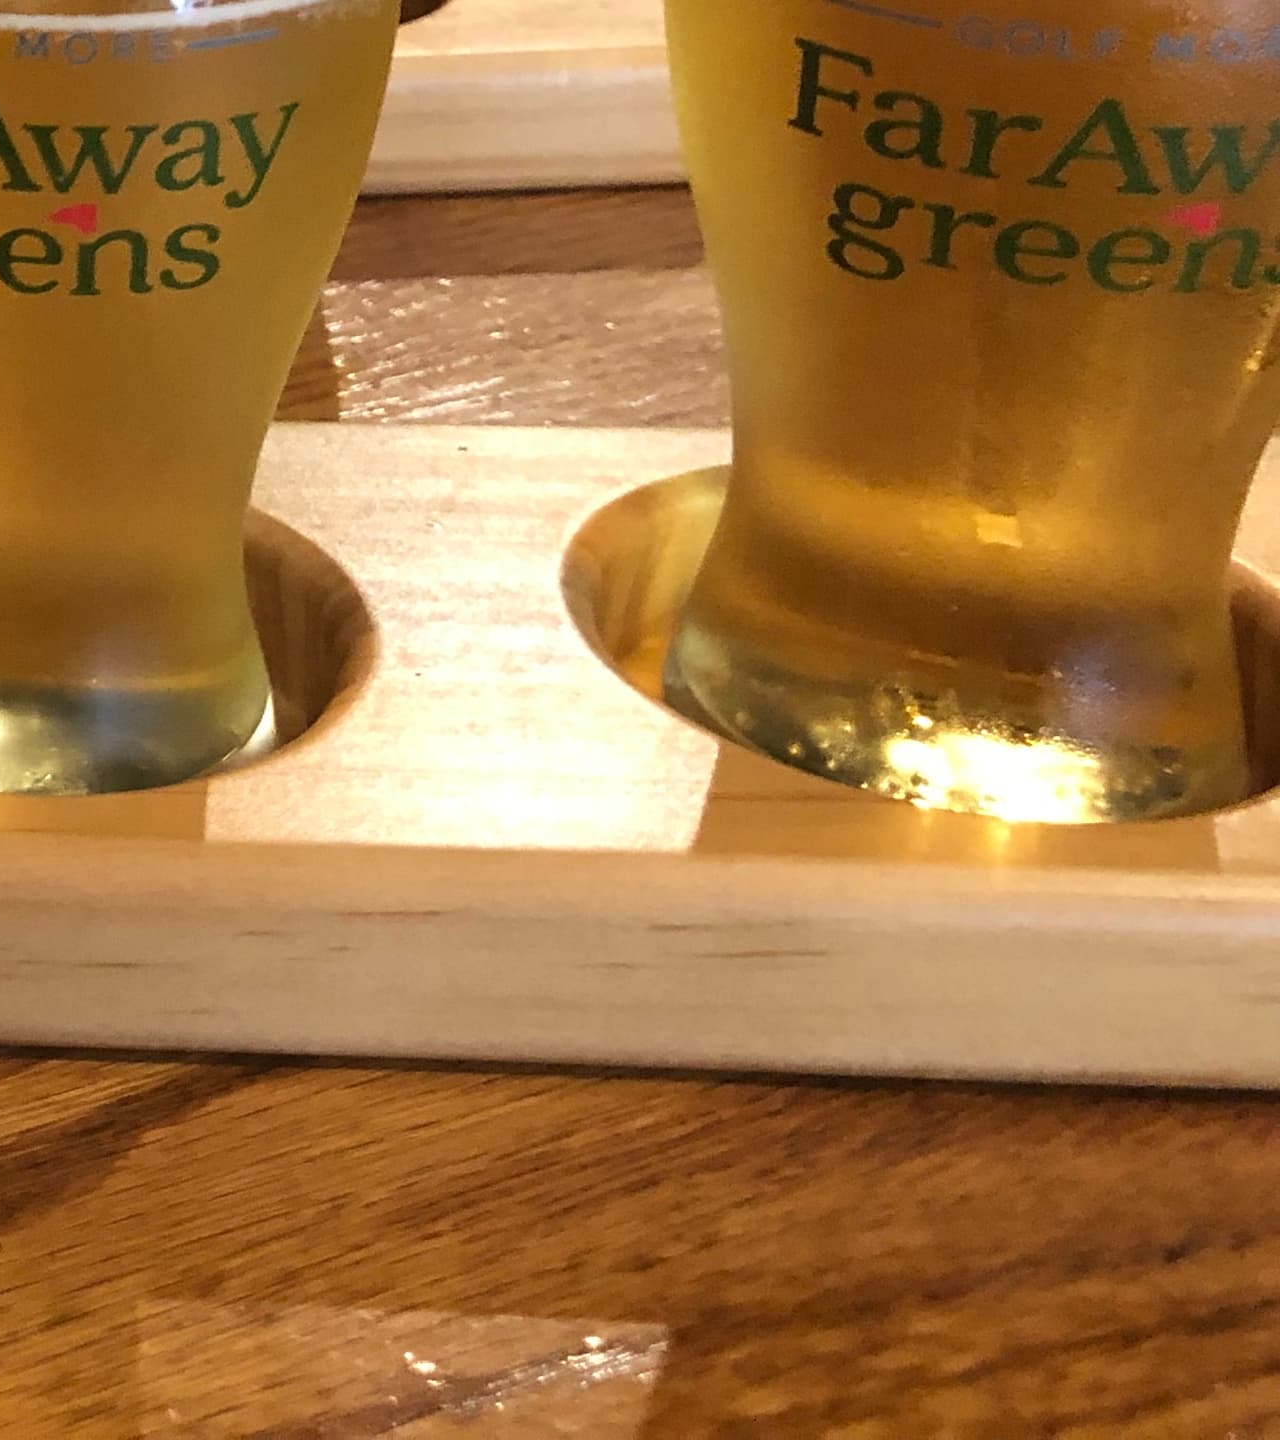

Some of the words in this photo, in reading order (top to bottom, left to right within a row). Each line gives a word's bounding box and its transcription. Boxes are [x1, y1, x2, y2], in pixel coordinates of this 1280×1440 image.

[14, 28, 175, 66] MORE
[953, 14, 1125, 61] GOLF
[825, 180, 1280, 294] green
